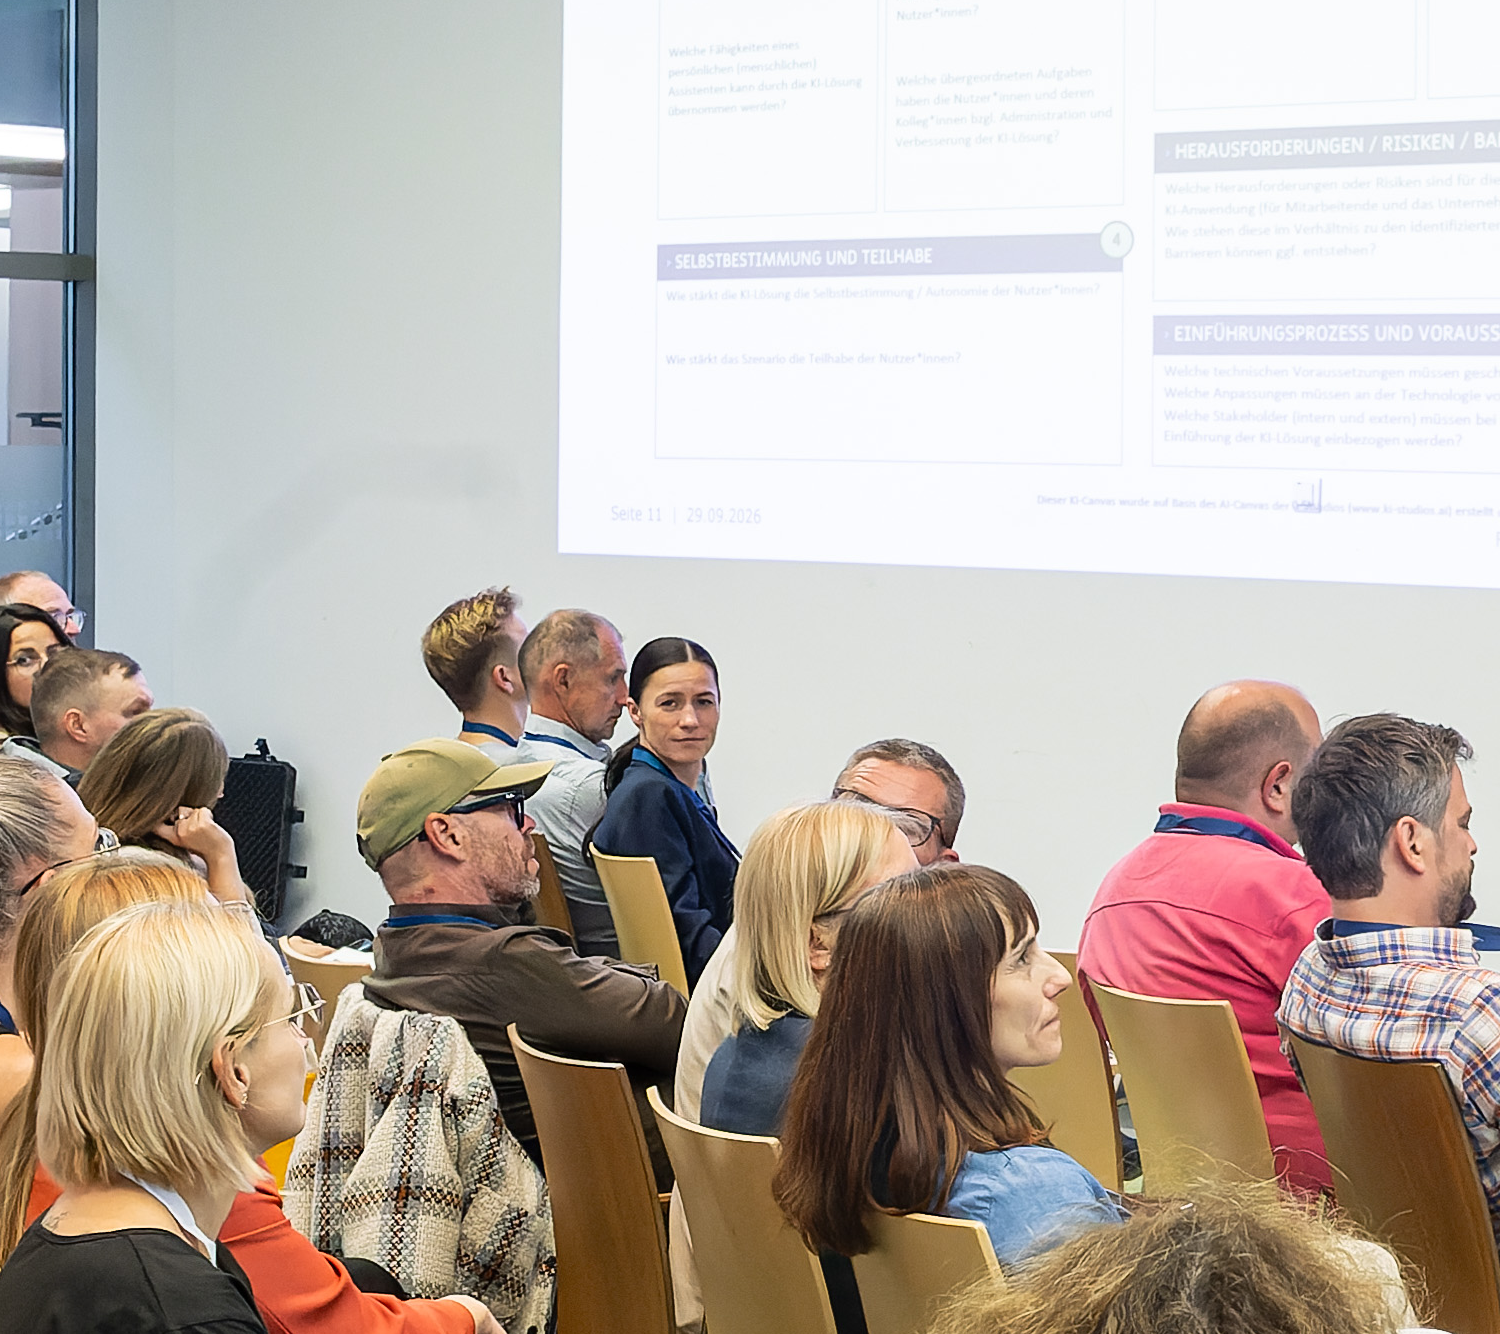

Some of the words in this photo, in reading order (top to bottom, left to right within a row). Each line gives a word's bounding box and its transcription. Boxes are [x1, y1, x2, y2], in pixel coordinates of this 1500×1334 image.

[1173, 136, 1365, 159] HERAUSFORDERUNGEN
[1381, 132, 1455, 152] RISIKEN
[1112, 232, 1121, 247] 4
[673, 249, 822, 269] SELBSTBESTIMMUNG
[825, 248, 858, 266] UND
[860, 246, 933, 265] TEILHABE
[1173, 322, 1370, 342] EINFÜHRUNGSPROZESS
[1373, 323, 1414, 342] UND
